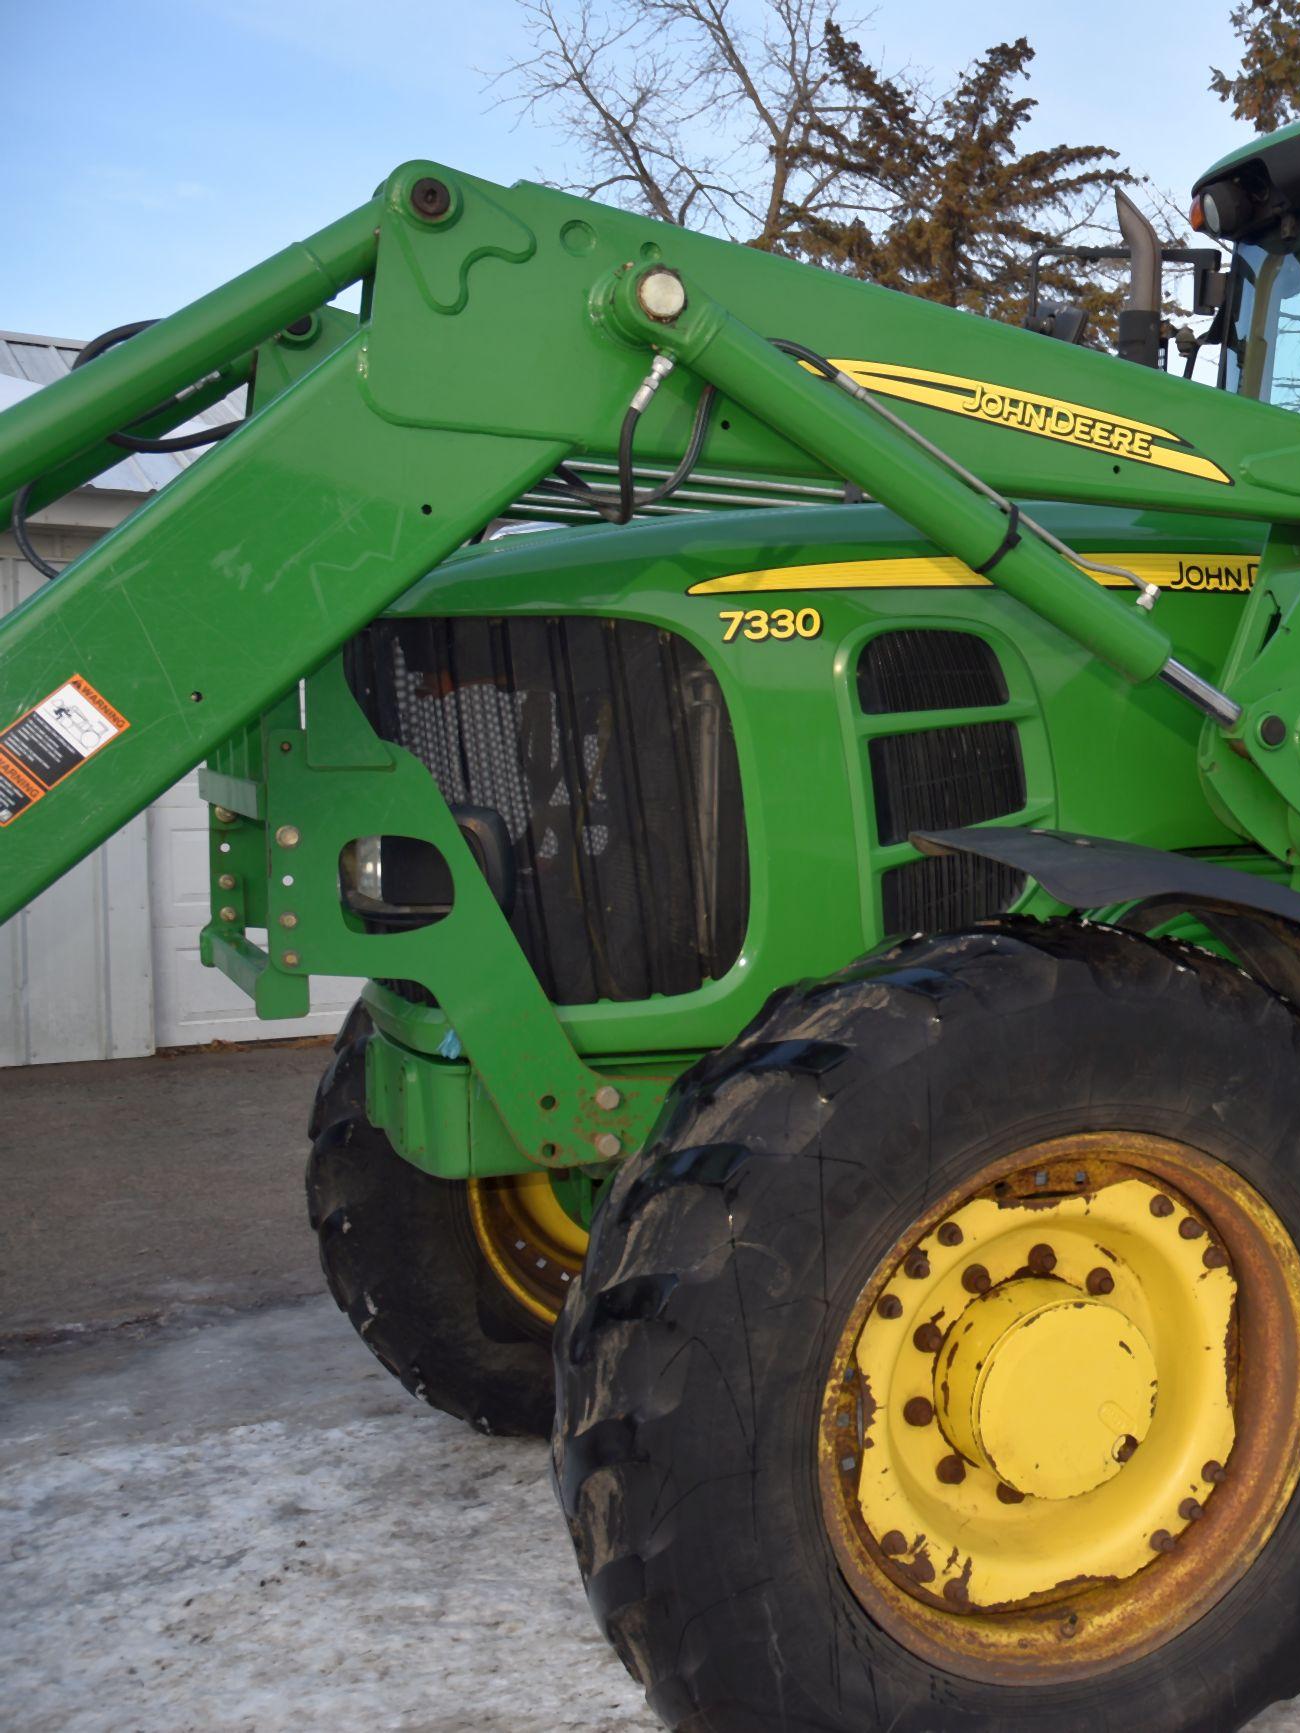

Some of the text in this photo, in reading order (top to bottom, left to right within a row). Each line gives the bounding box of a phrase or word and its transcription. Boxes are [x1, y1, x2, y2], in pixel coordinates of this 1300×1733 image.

[963, 385, 1153, 459] JOHN DEERE
[1170, 561, 1242, 588] JOHN
[719, 608, 822, 643] 7330
[81, 687, 126, 729] WARNING
